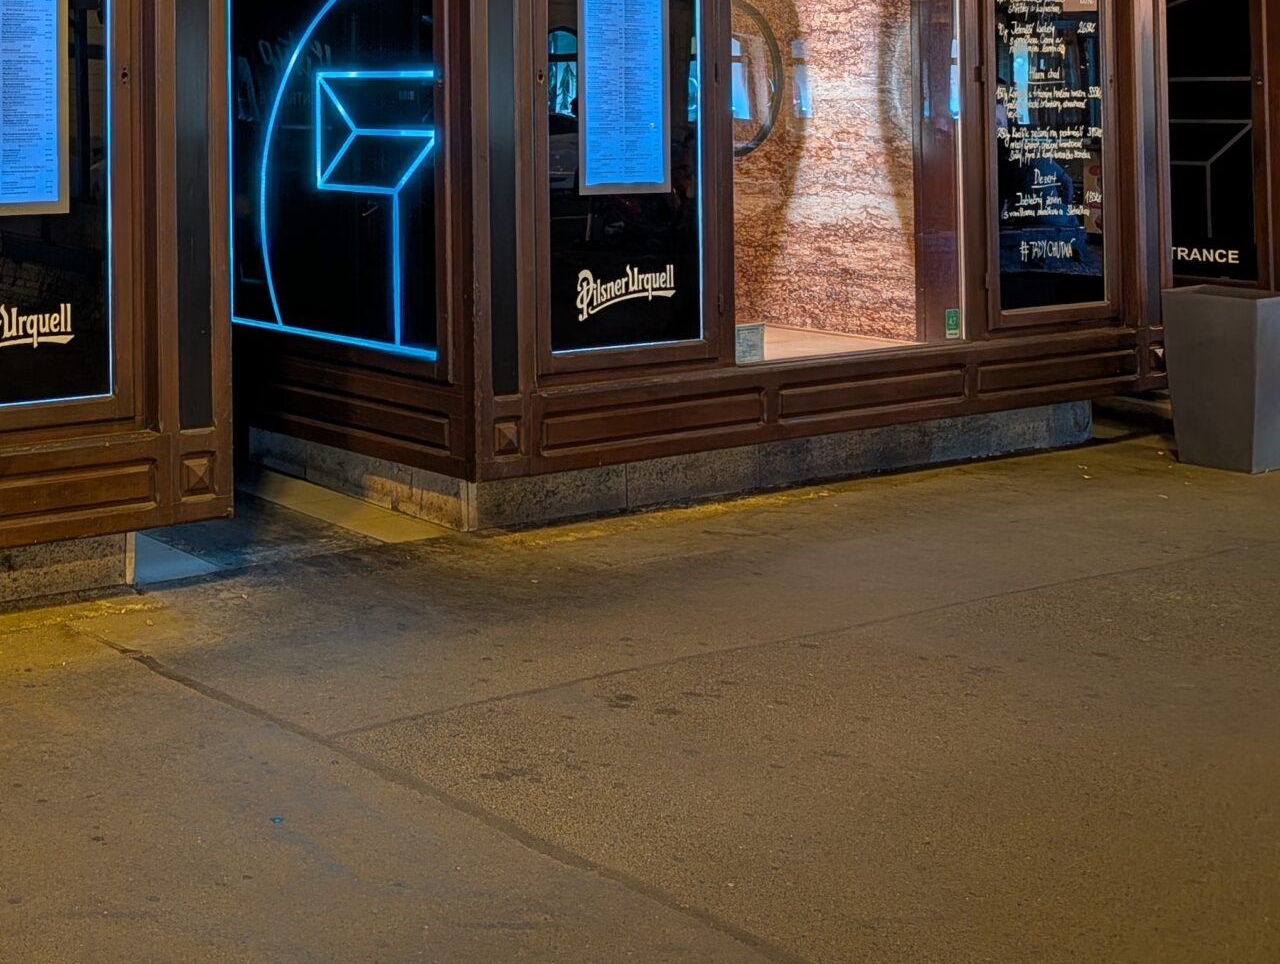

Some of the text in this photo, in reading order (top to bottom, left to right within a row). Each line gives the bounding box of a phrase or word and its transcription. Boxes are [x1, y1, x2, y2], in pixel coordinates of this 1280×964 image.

[576, 264, 674, 322] Pilsner Urquell
[0, 304, 72, 348] Urquell
